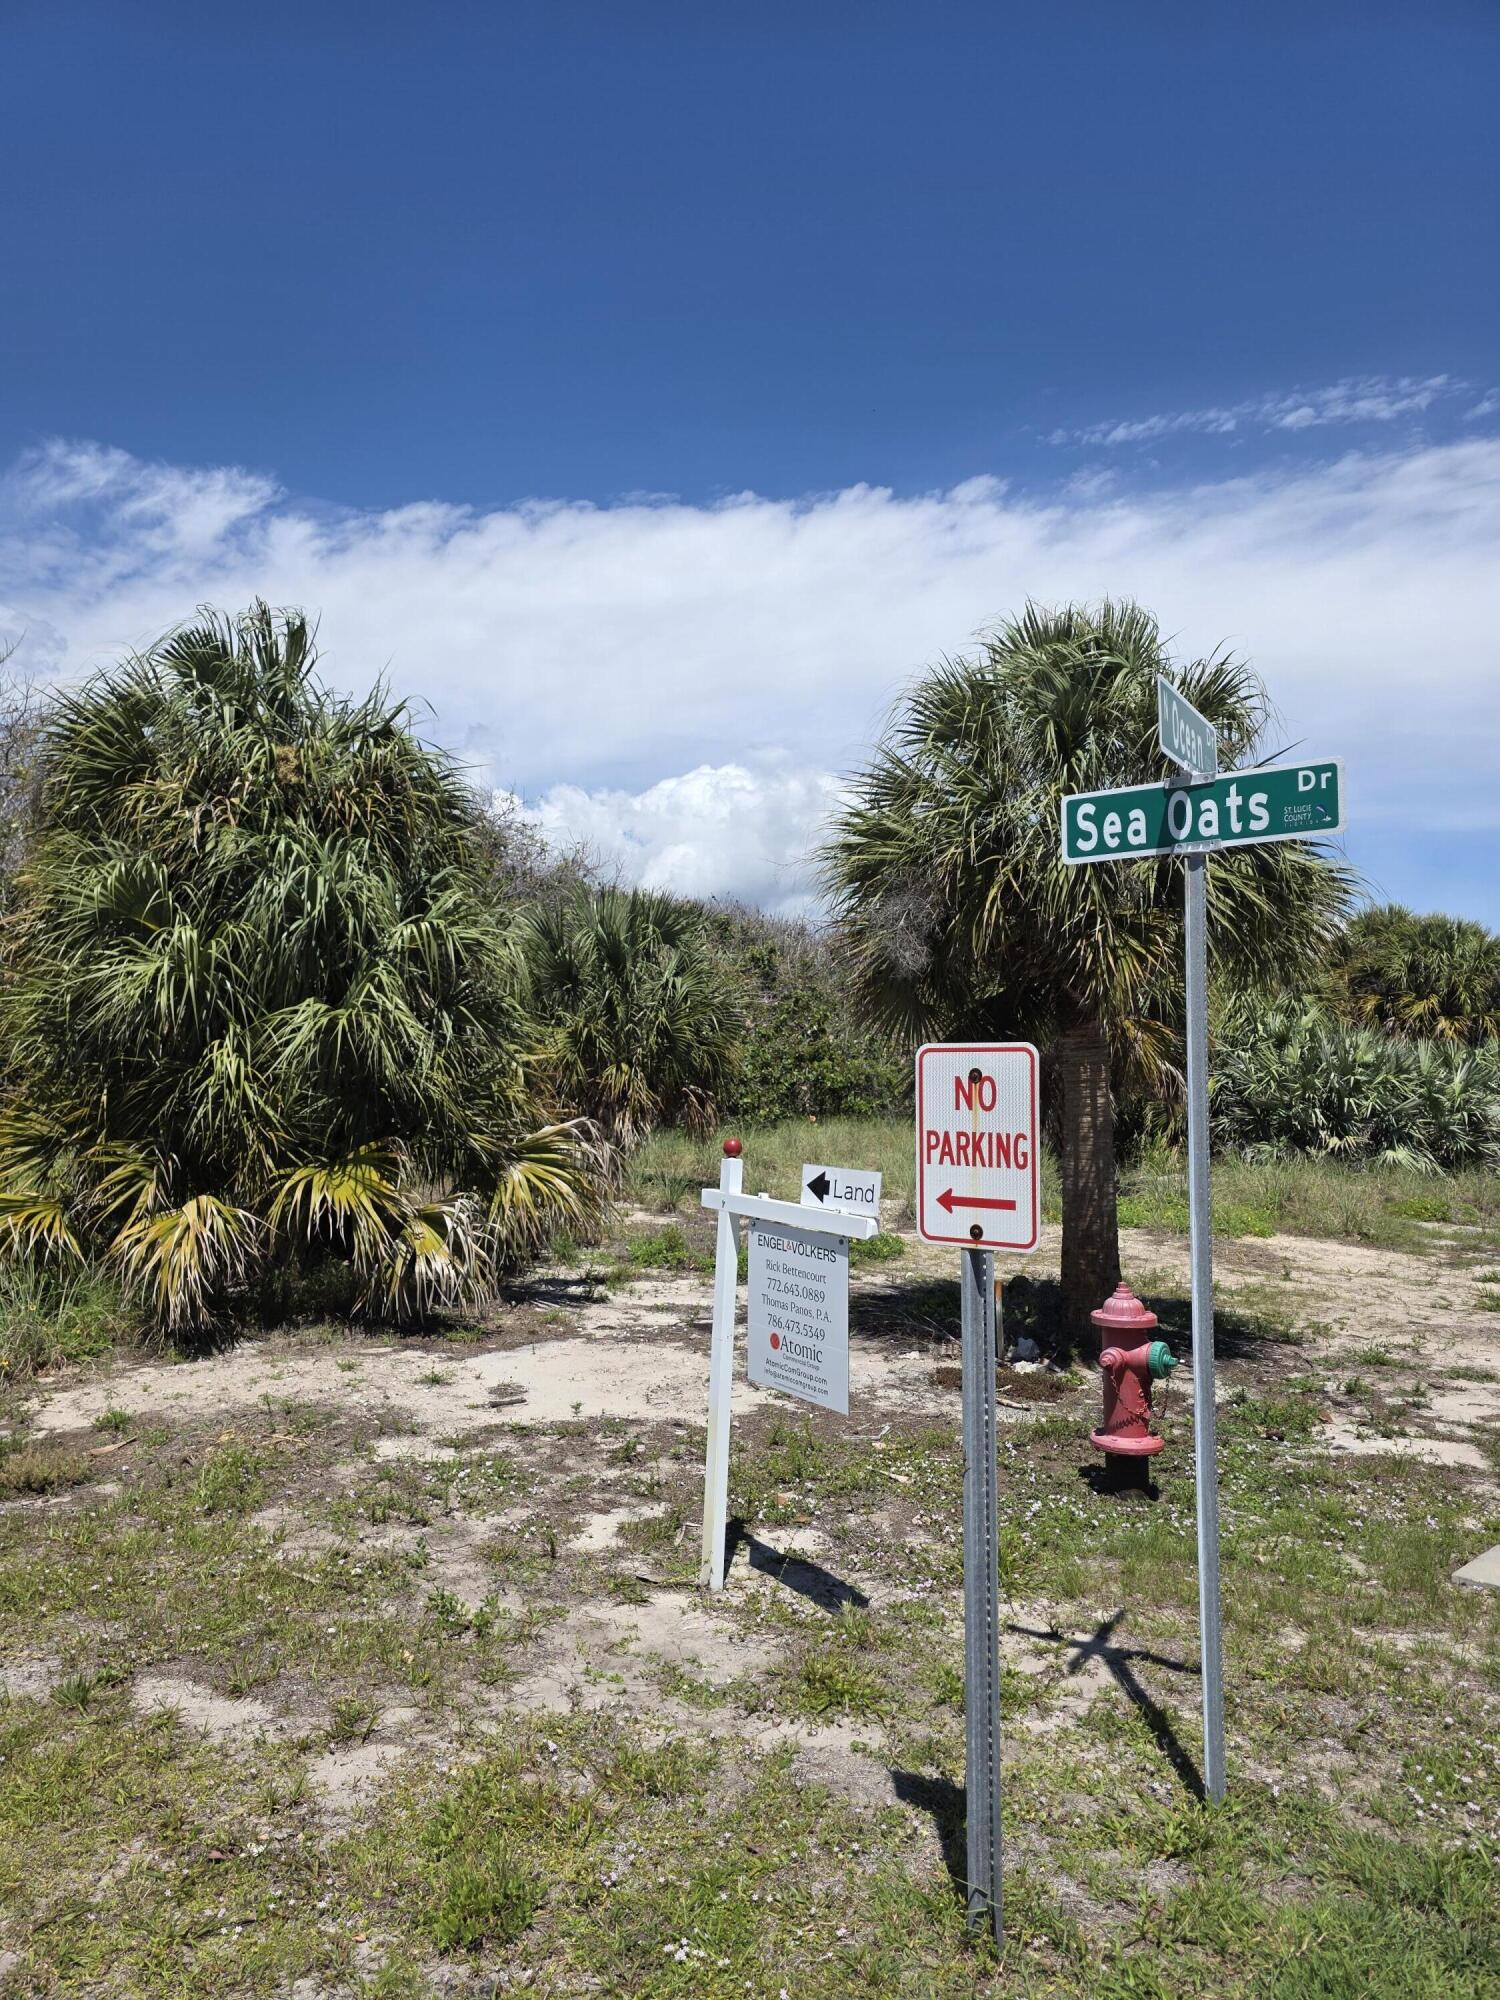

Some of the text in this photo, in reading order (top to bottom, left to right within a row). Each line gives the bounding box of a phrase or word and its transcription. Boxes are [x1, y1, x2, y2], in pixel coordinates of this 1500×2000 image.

[1172, 700, 1205, 770] Ocean
[1076, 770, 1332, 851] Sea Oats Dr
[1284, 812, 1312, 822] COUNTY
[954, 1075, 997, 1112] NO
[926, 1130, 1028, 1170] PARKING
[833, 1180, 875, 1203] Land
[766, 1259, 827, 1284] Rick Bettencourt
[767, 1277, 826, 1303] 772.643.0889
[761, 1293, 832, 1323] Thomas Panos, P.A.
[767, 1313, 826, 1341] 786.473.5349
[780, 1335, 823, 1363] Atomic
